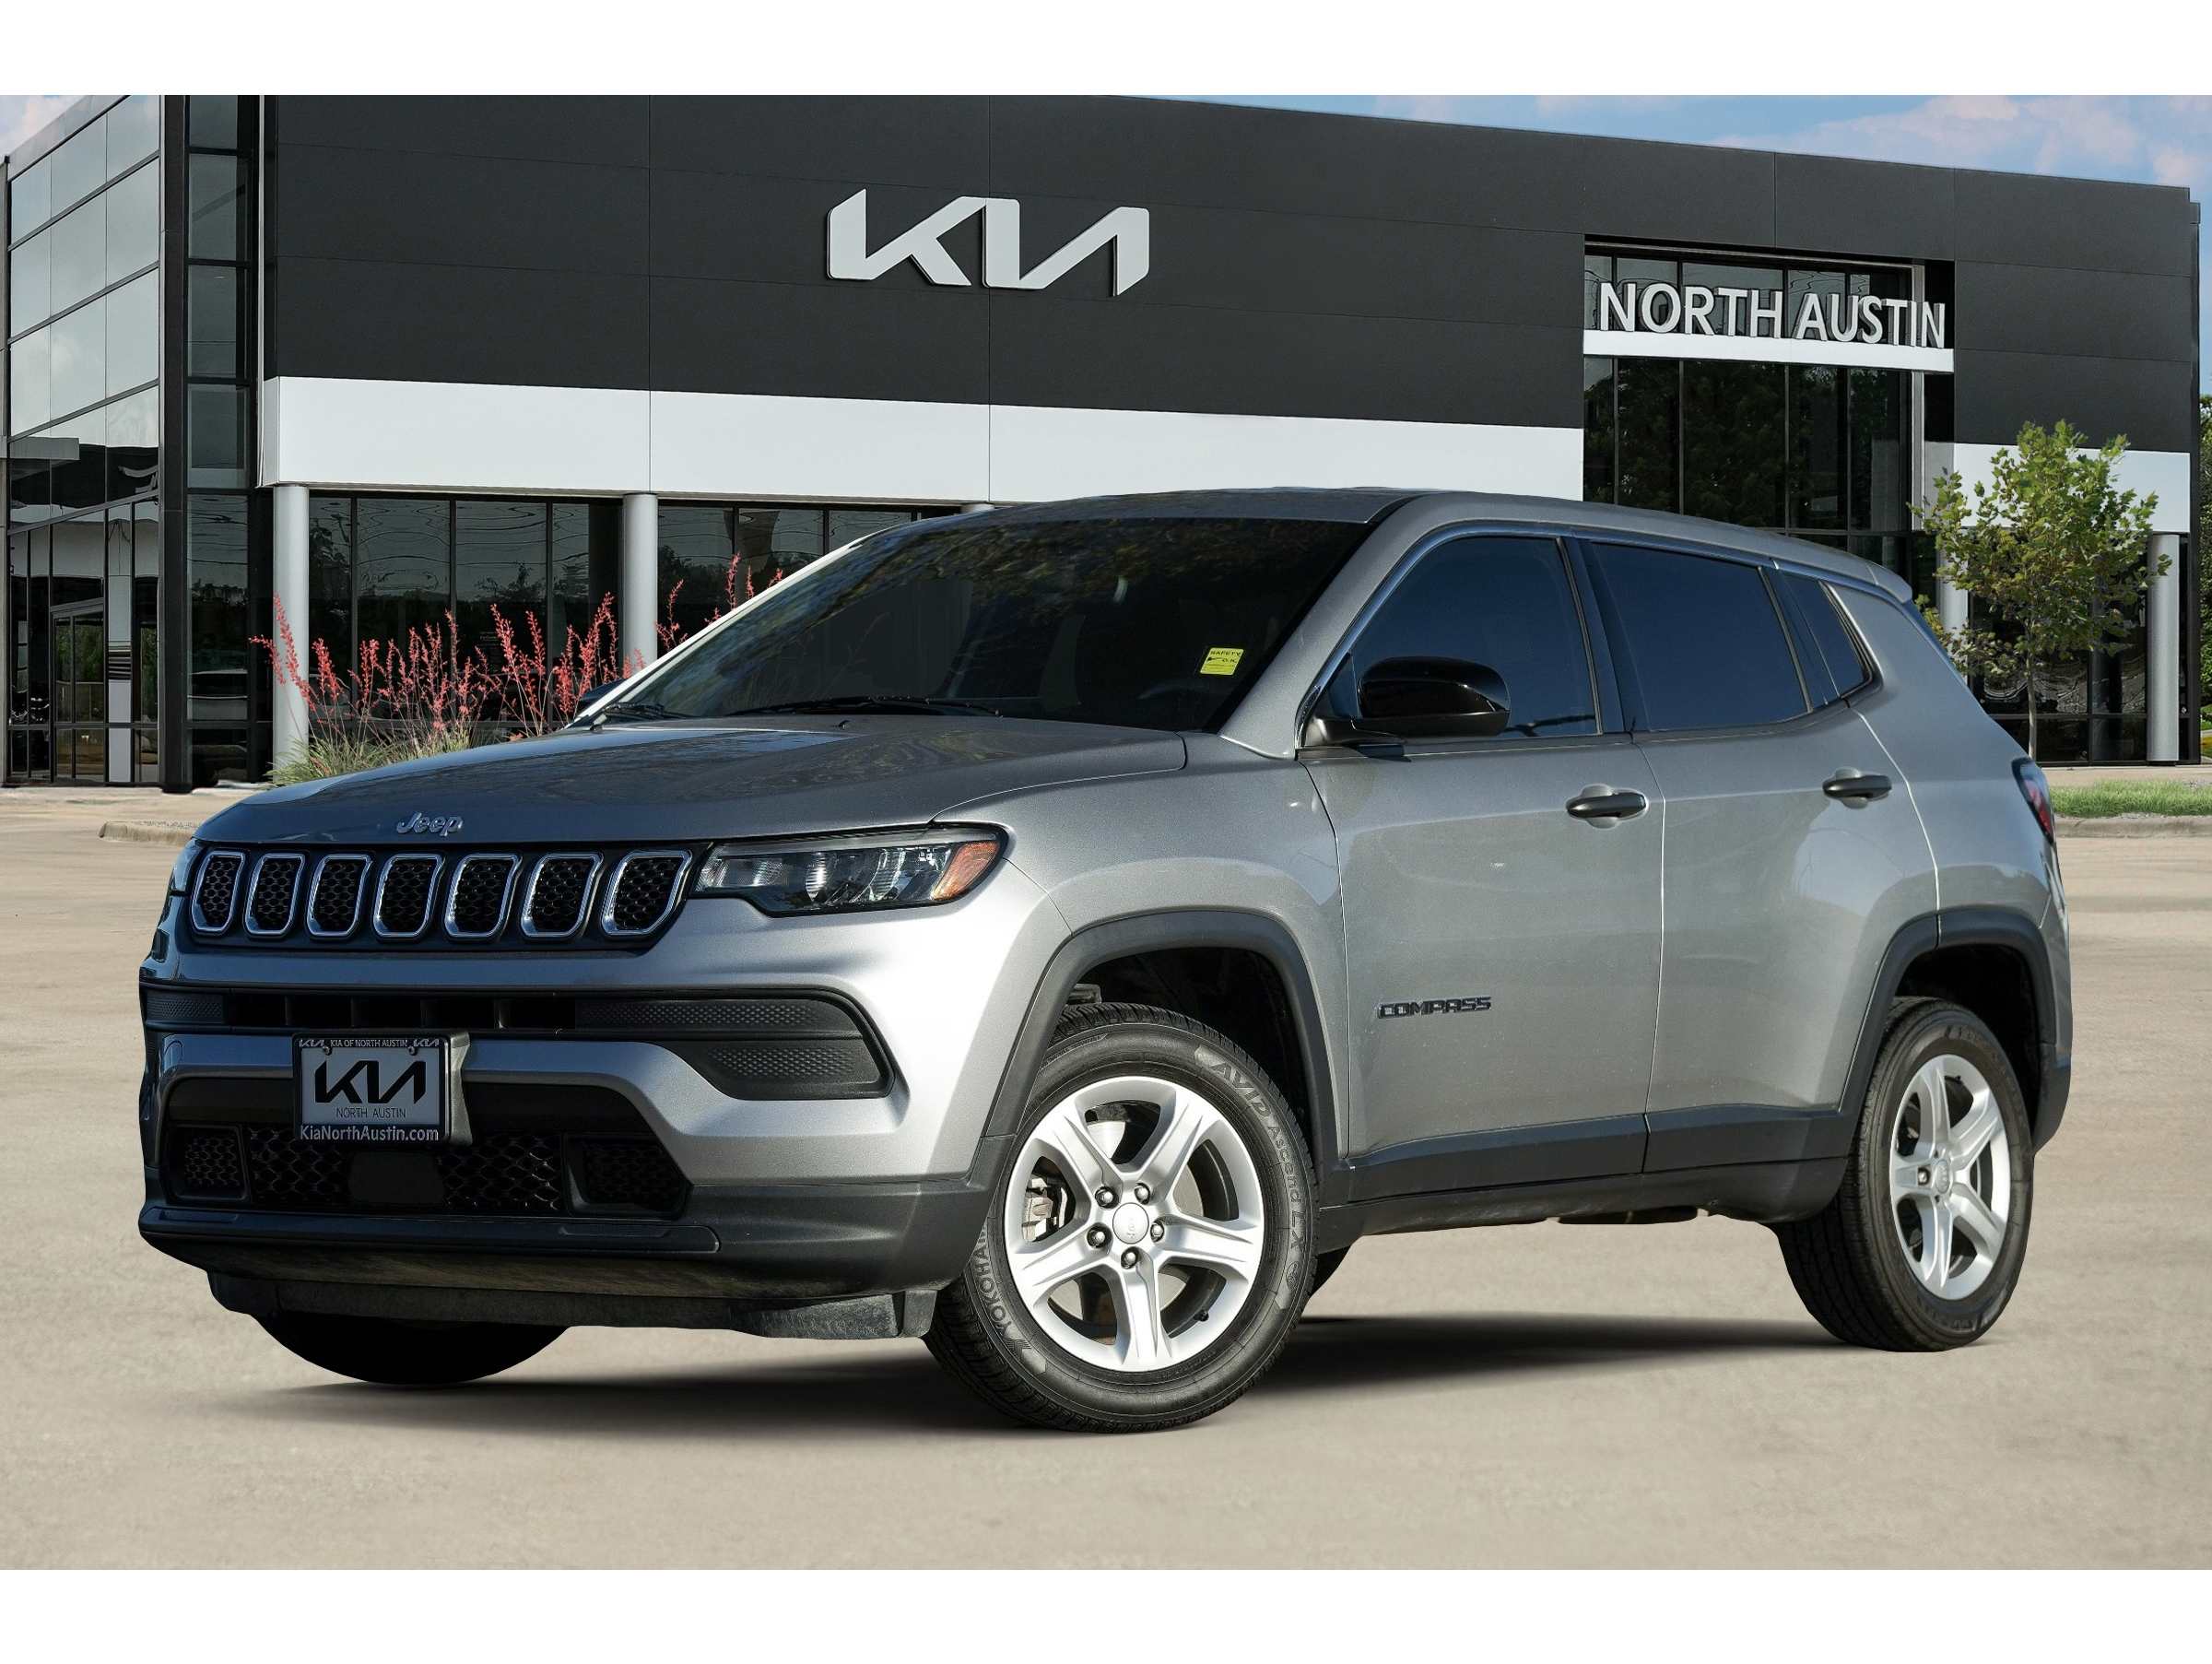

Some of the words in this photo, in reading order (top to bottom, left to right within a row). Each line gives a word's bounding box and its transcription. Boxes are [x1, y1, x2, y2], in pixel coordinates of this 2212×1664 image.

[828, 189, 1149, 296] KIA
[1600, 282, 1783, 339] NORTH
[1791, 292, 1946, 349] AUSTIN
[396, 811, 464, 837] Jeep
[1377, 997, 1491, 1019] COMPASS
[330, 1039, 343, 1047] KIA
[344, 1039, 355, 1047] OF
[355, 1039, 381, 1047] NORTH
[382, 1039, 408, 1047] AUSTIN
[314, 1060, 426, 1104] KIA
[335, 1107, 368, 1118] NORTH
[372, 1107, 406, 1118] AUSTIN
[300, 1125, 439, 1140] KiaNorthAustin.com
[1208, 1062, 1272, 1117] AVID
[1267, 1125, 1301, 1203] Ascend
[972, 1227, 1013, 1337] YOKOHA
